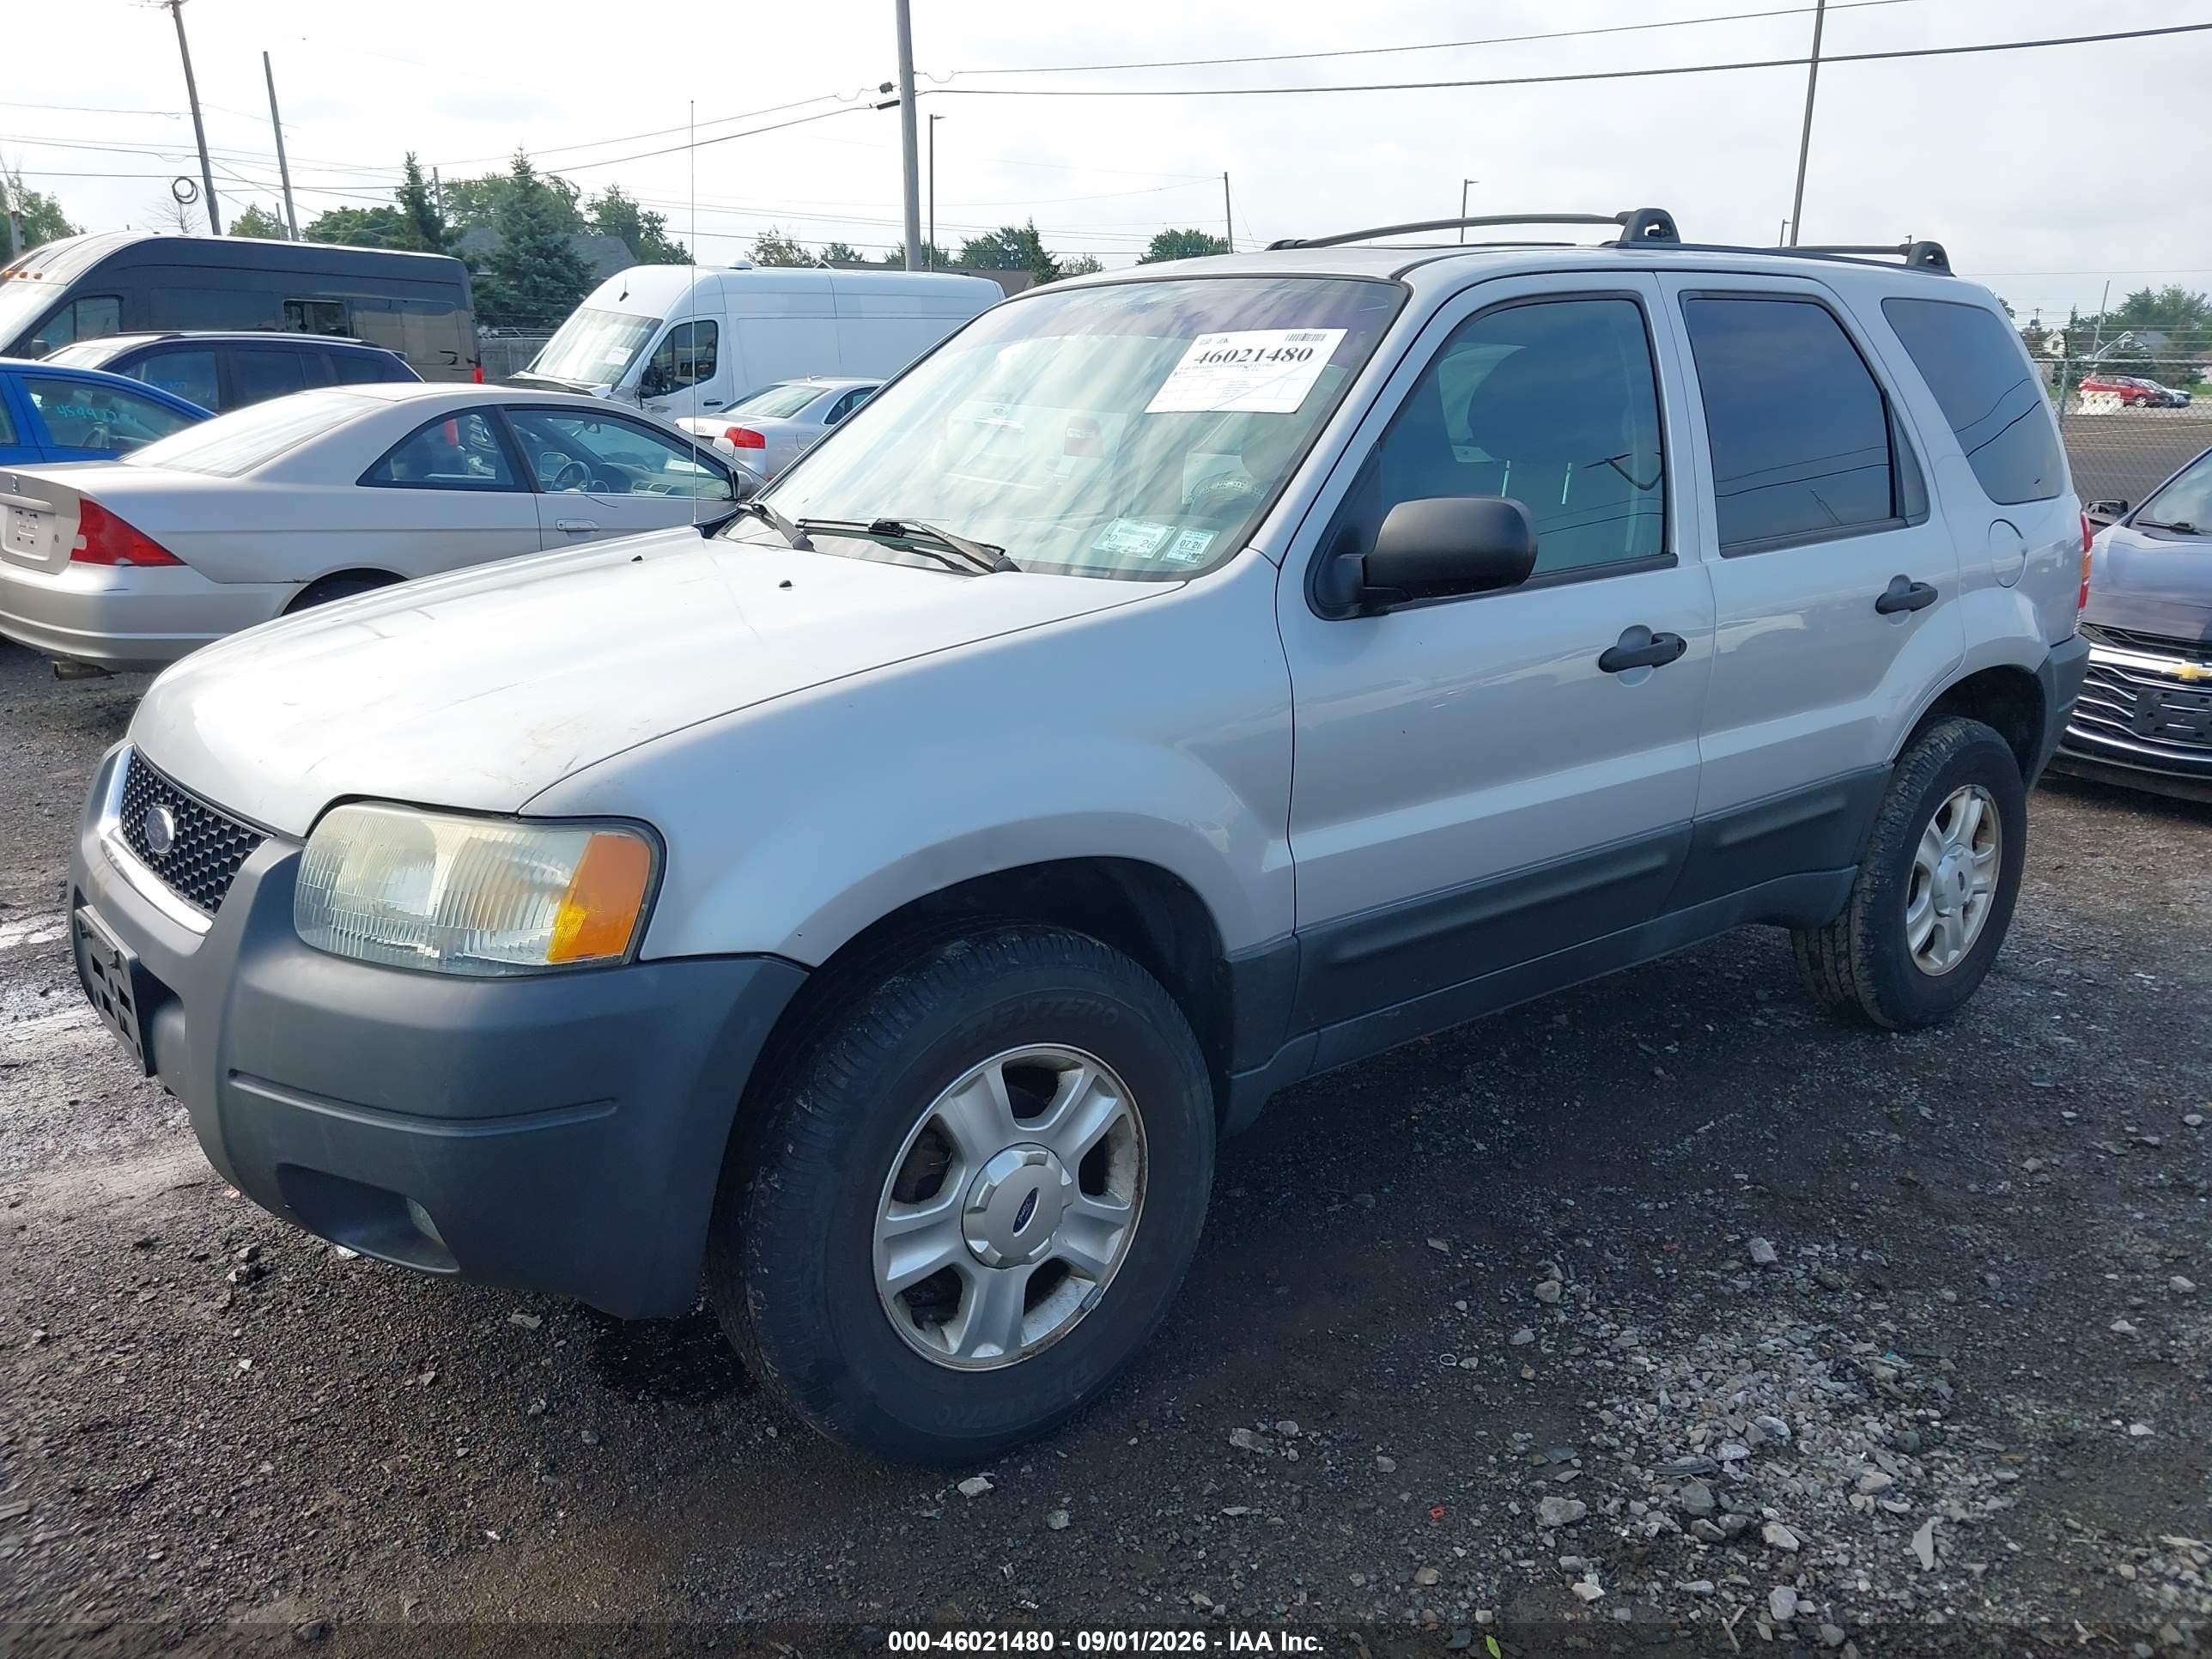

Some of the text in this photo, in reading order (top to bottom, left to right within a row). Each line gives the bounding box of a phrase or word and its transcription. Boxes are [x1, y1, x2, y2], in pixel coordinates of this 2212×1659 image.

[1194, 347, 1314, 365] 46021480
[1105, 533, 1118, 544] 10
[1139, 538, 1156, 550] 26
